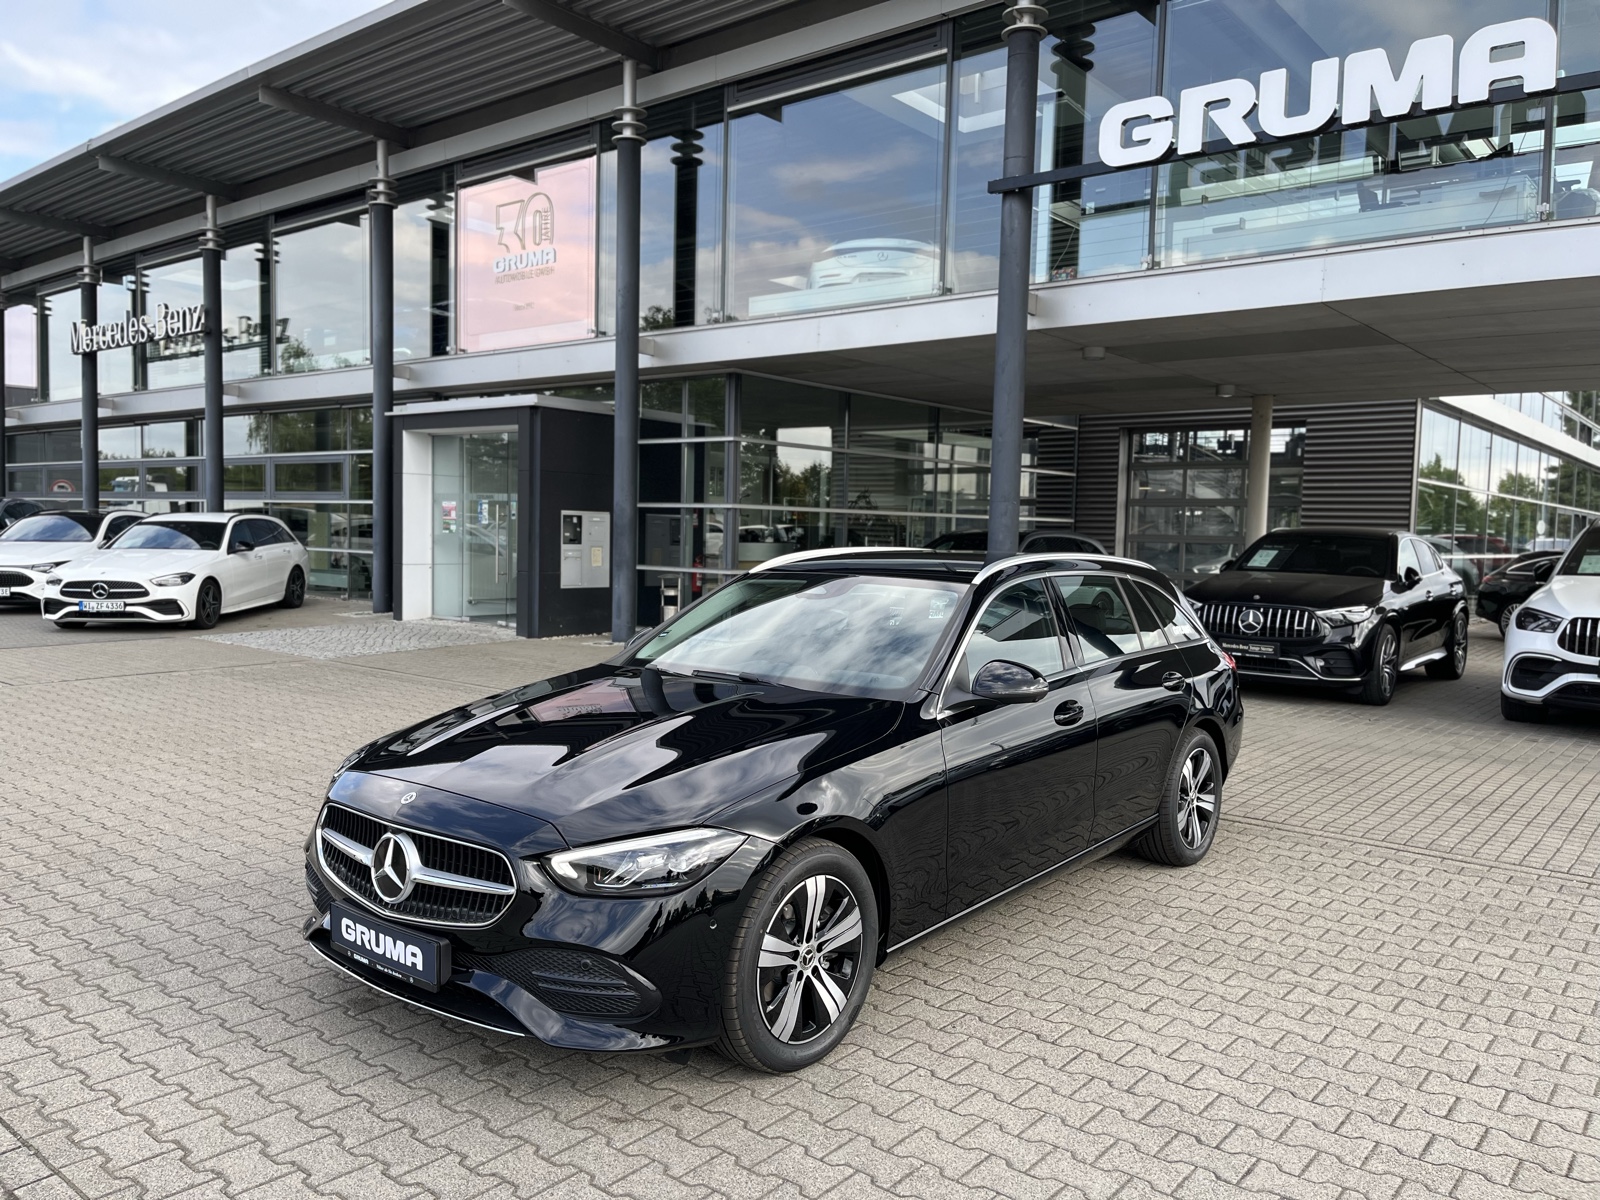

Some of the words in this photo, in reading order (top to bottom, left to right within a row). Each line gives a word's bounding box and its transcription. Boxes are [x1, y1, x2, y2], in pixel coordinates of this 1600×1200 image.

[1098, 18, 1557, 167] GRUMA
[492, 247, 557, 273] GRUMA
[70, 303, 206, 354] Mercedes-Benz
[105, 602, 123, 610] 4336
[341, 917, 423, 971] GRUMA
